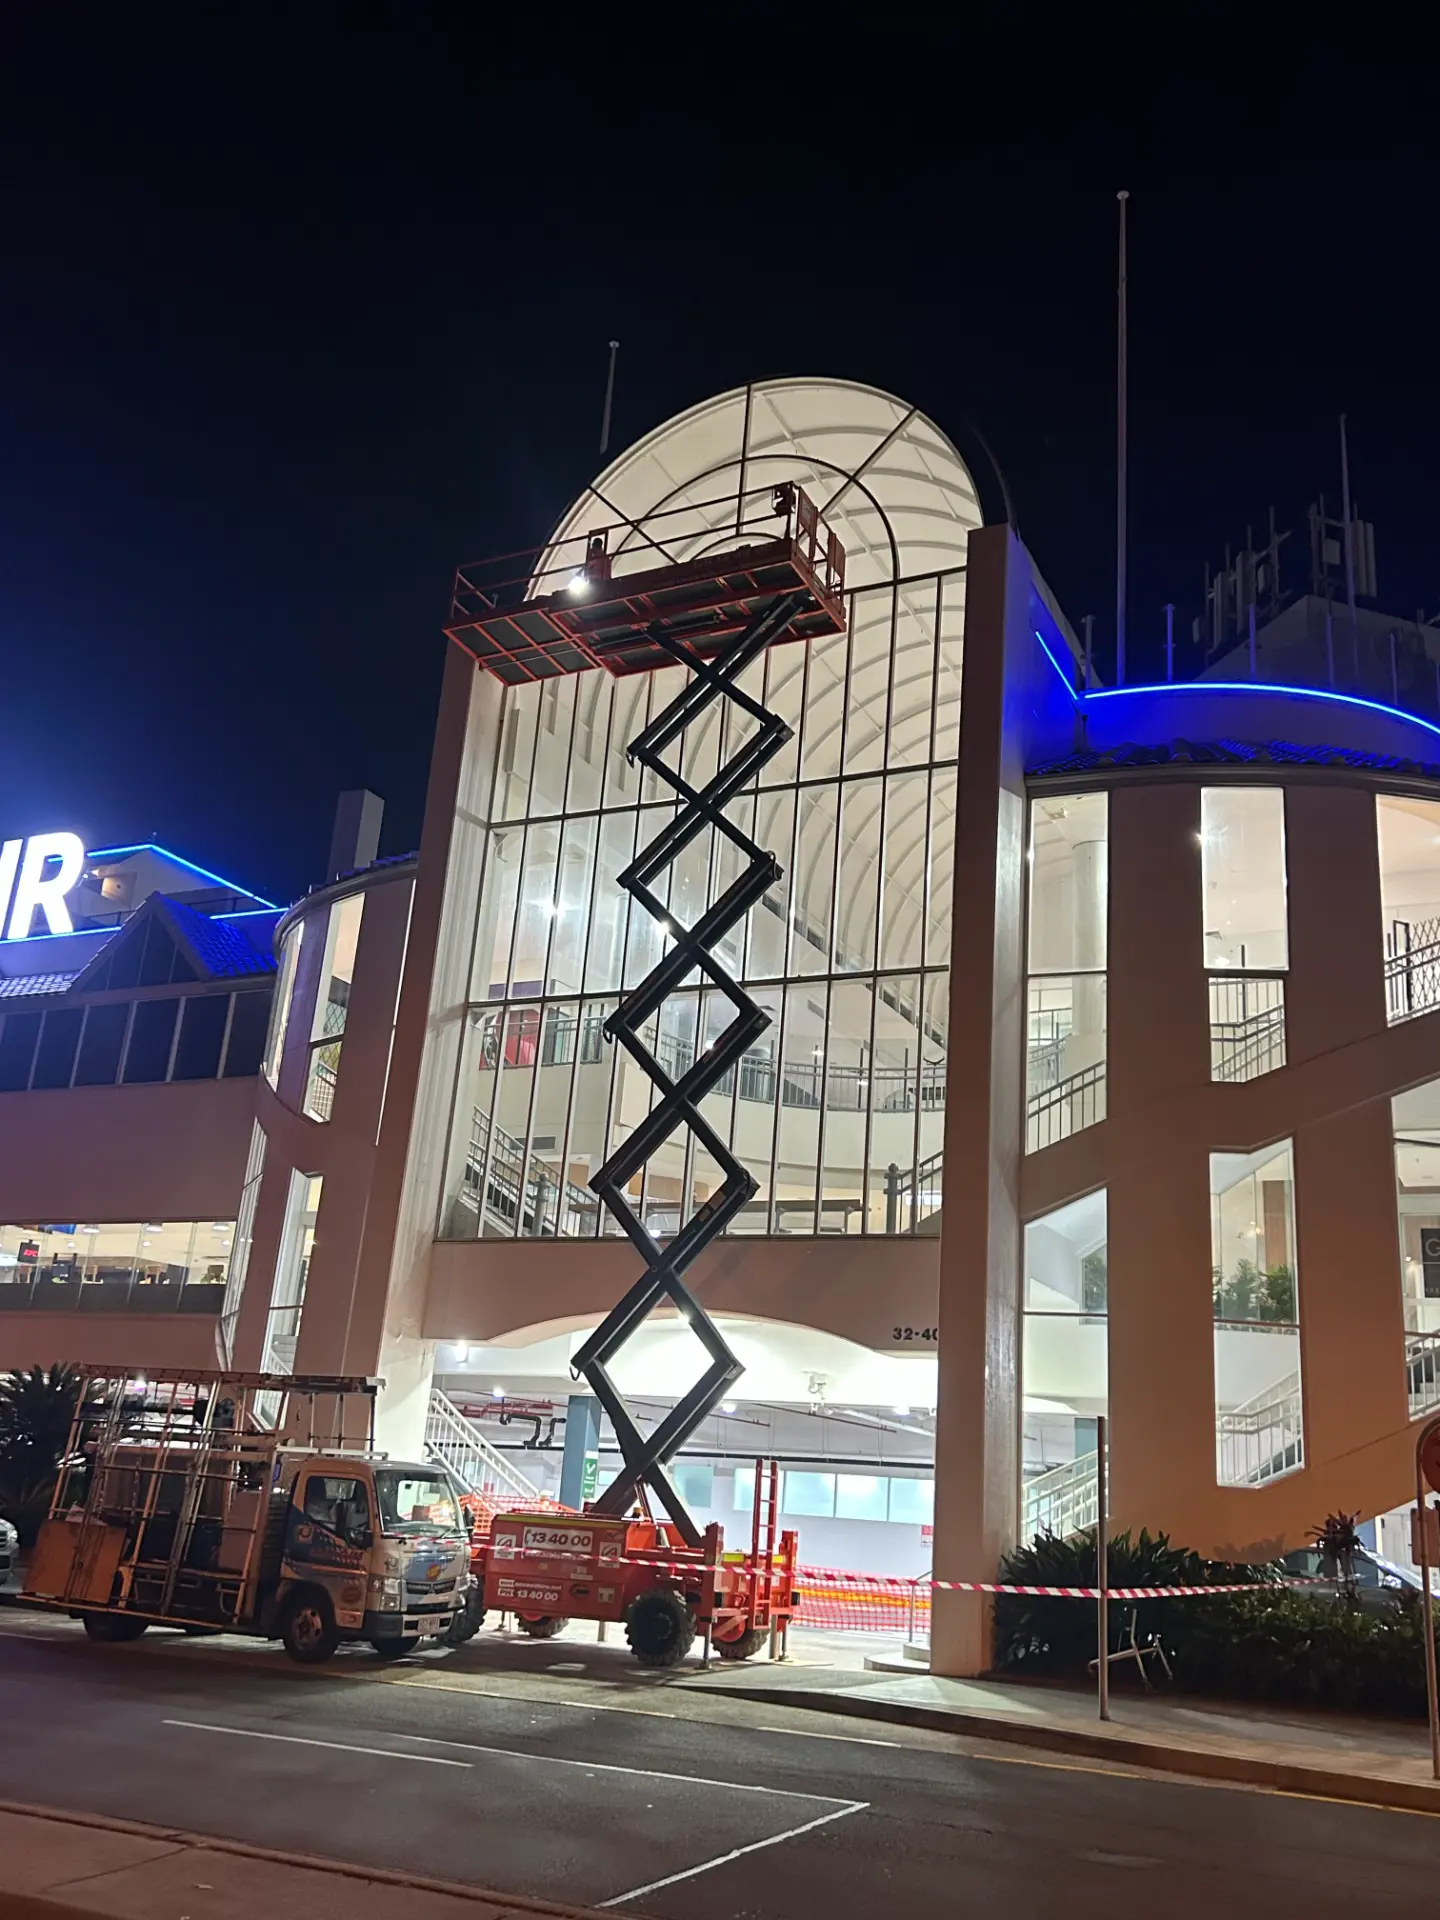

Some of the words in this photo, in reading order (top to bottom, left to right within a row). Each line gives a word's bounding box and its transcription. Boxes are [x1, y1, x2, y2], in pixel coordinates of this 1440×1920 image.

[531, 1532, 545, 1543] 13
[549, 1533, 568, 1545] 40
[571, 1535, 591, 1547] 00
[517, 1589, 528, 1598] 13
[528, 1590, 543, 1599] 40
[544, 1592, 558, 1601] 00
